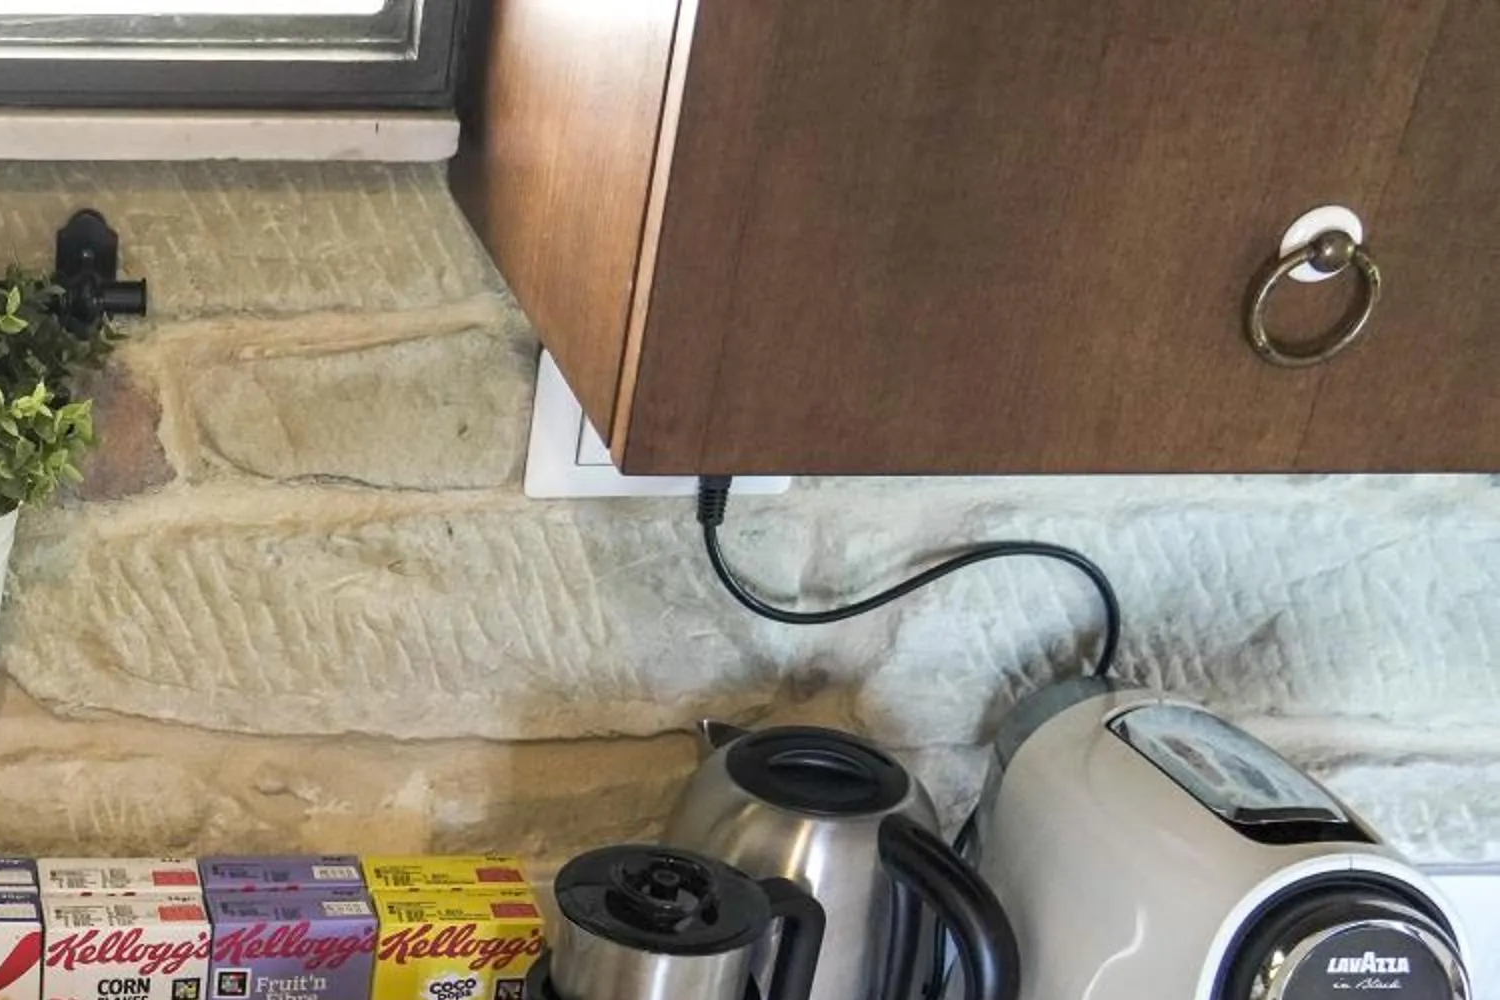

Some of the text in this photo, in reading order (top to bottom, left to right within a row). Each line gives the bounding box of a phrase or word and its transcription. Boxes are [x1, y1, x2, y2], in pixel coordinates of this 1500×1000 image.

[46, 928, 212, 975] Kellogg's
[214, 920, 379, 970] Kellogg's
[378, 923, 543, 971] Kellogg's
[1327, 951, 1410, 973] LAVAZZA
[97, 978, 150, 995] CORN
[255, 974, 326, 993] Fruit'n
